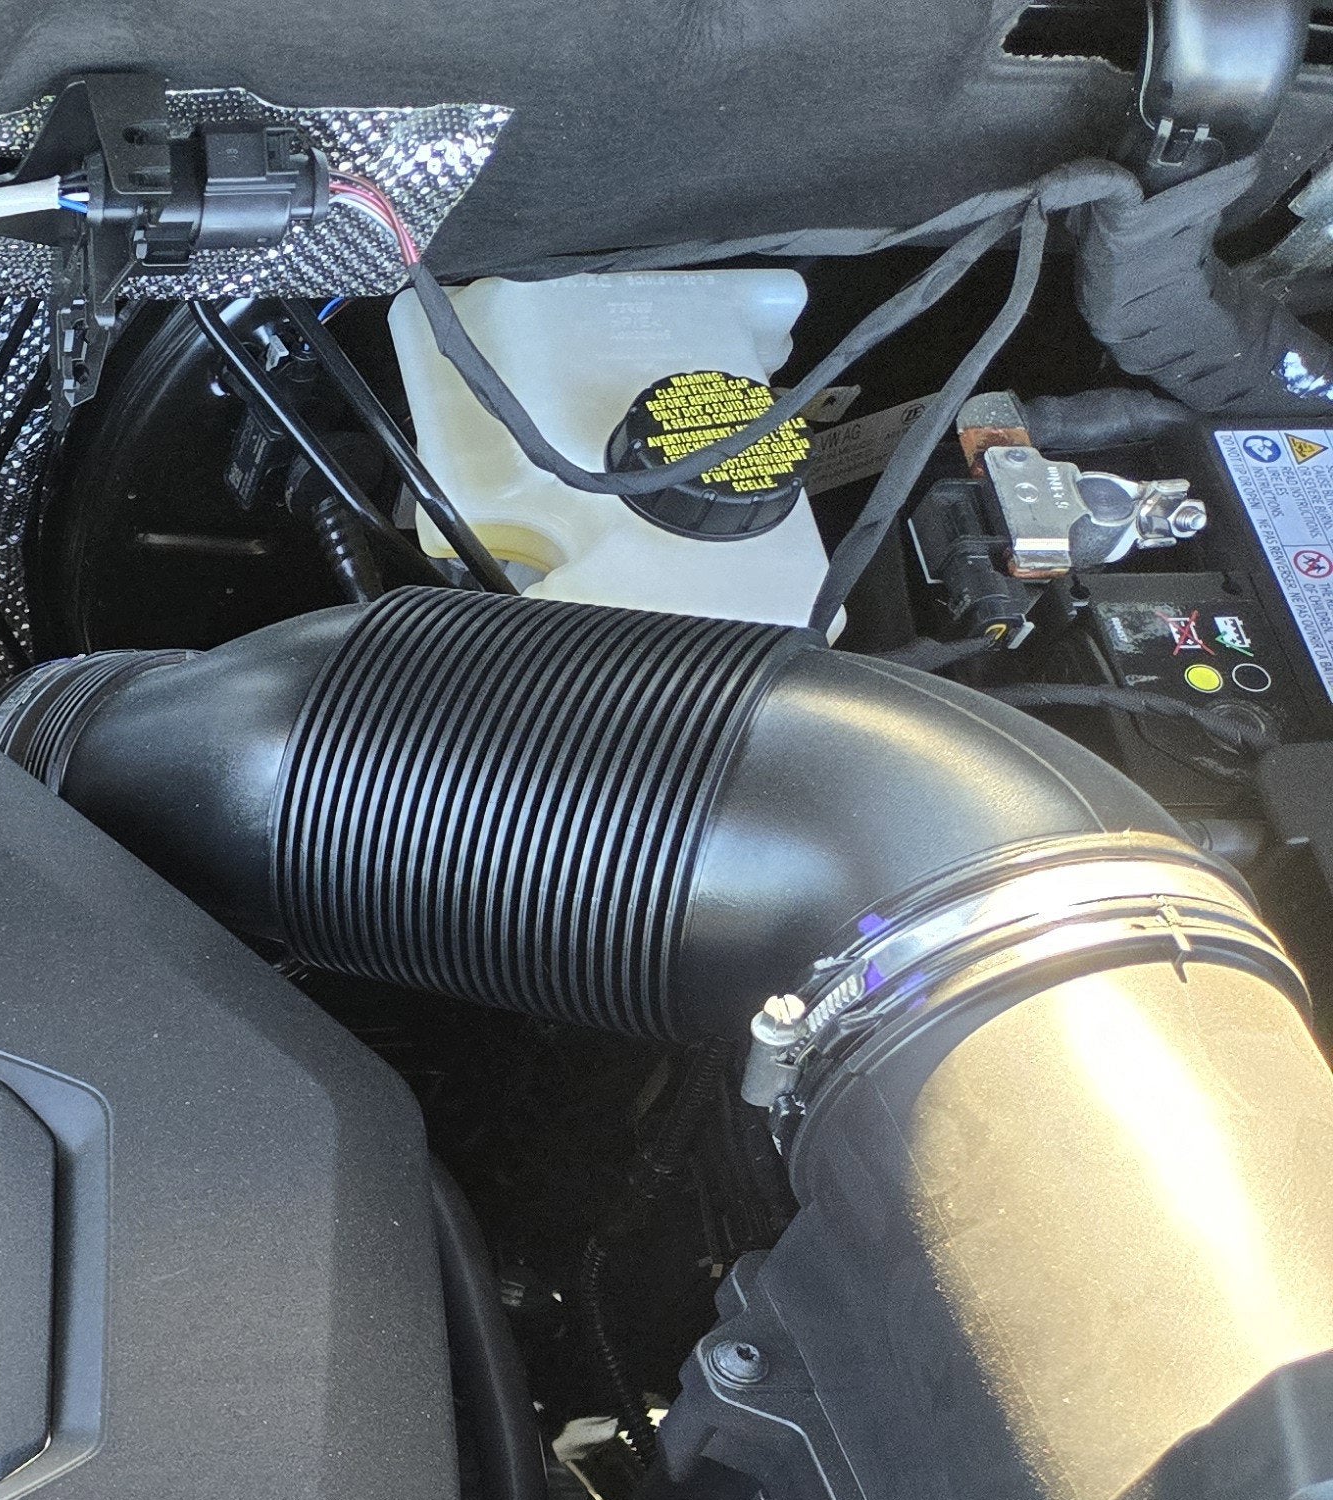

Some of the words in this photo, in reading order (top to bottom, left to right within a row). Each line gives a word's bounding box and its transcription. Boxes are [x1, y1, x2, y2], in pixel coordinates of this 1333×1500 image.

[670, 372, 724, 387] WARNING:
[655, 383, 691, 399] CLEAN
[692, 380, 726, 396] FILLER
[728, 378, 749, 391] CAP
[646, 396, 690, 412] BEFORE
[748, 386, 770, 398] USE
[653, 409, 683, 422] ONLY
[683, 405, 705, 419] DOT
[713, 400, 744, 413] FLUID
[745, 397, 774, 410] FROM
[663, 420, 671, 431] A
[671, 414, 712, 430] SEALED
[647, 427, 735, 447] AVERTISSEMENT:
[663, 440, 715, 456] BOUCHO
[771, 442, 796, 452] QUE
[797, 438, 810, 449] DU
[748, 451, 807, 466] PROVENANT
[1227, 447, 1242, 462] NOT
[701, 472, 730, 484] D'UN
[730, 462, 794, 482] CONTENANT
[1267, 467, 1282, 481] LIRE
[1283, 467, 1298, 485] READ
[1274, 485, 1290, 496] LES
[1258, 519, 1271, 530] NE
[1263, 533, 1278, 544] PAS
[1290, 593, 1305, 604] NE
[1294, 605, 1311, 619] PAS
